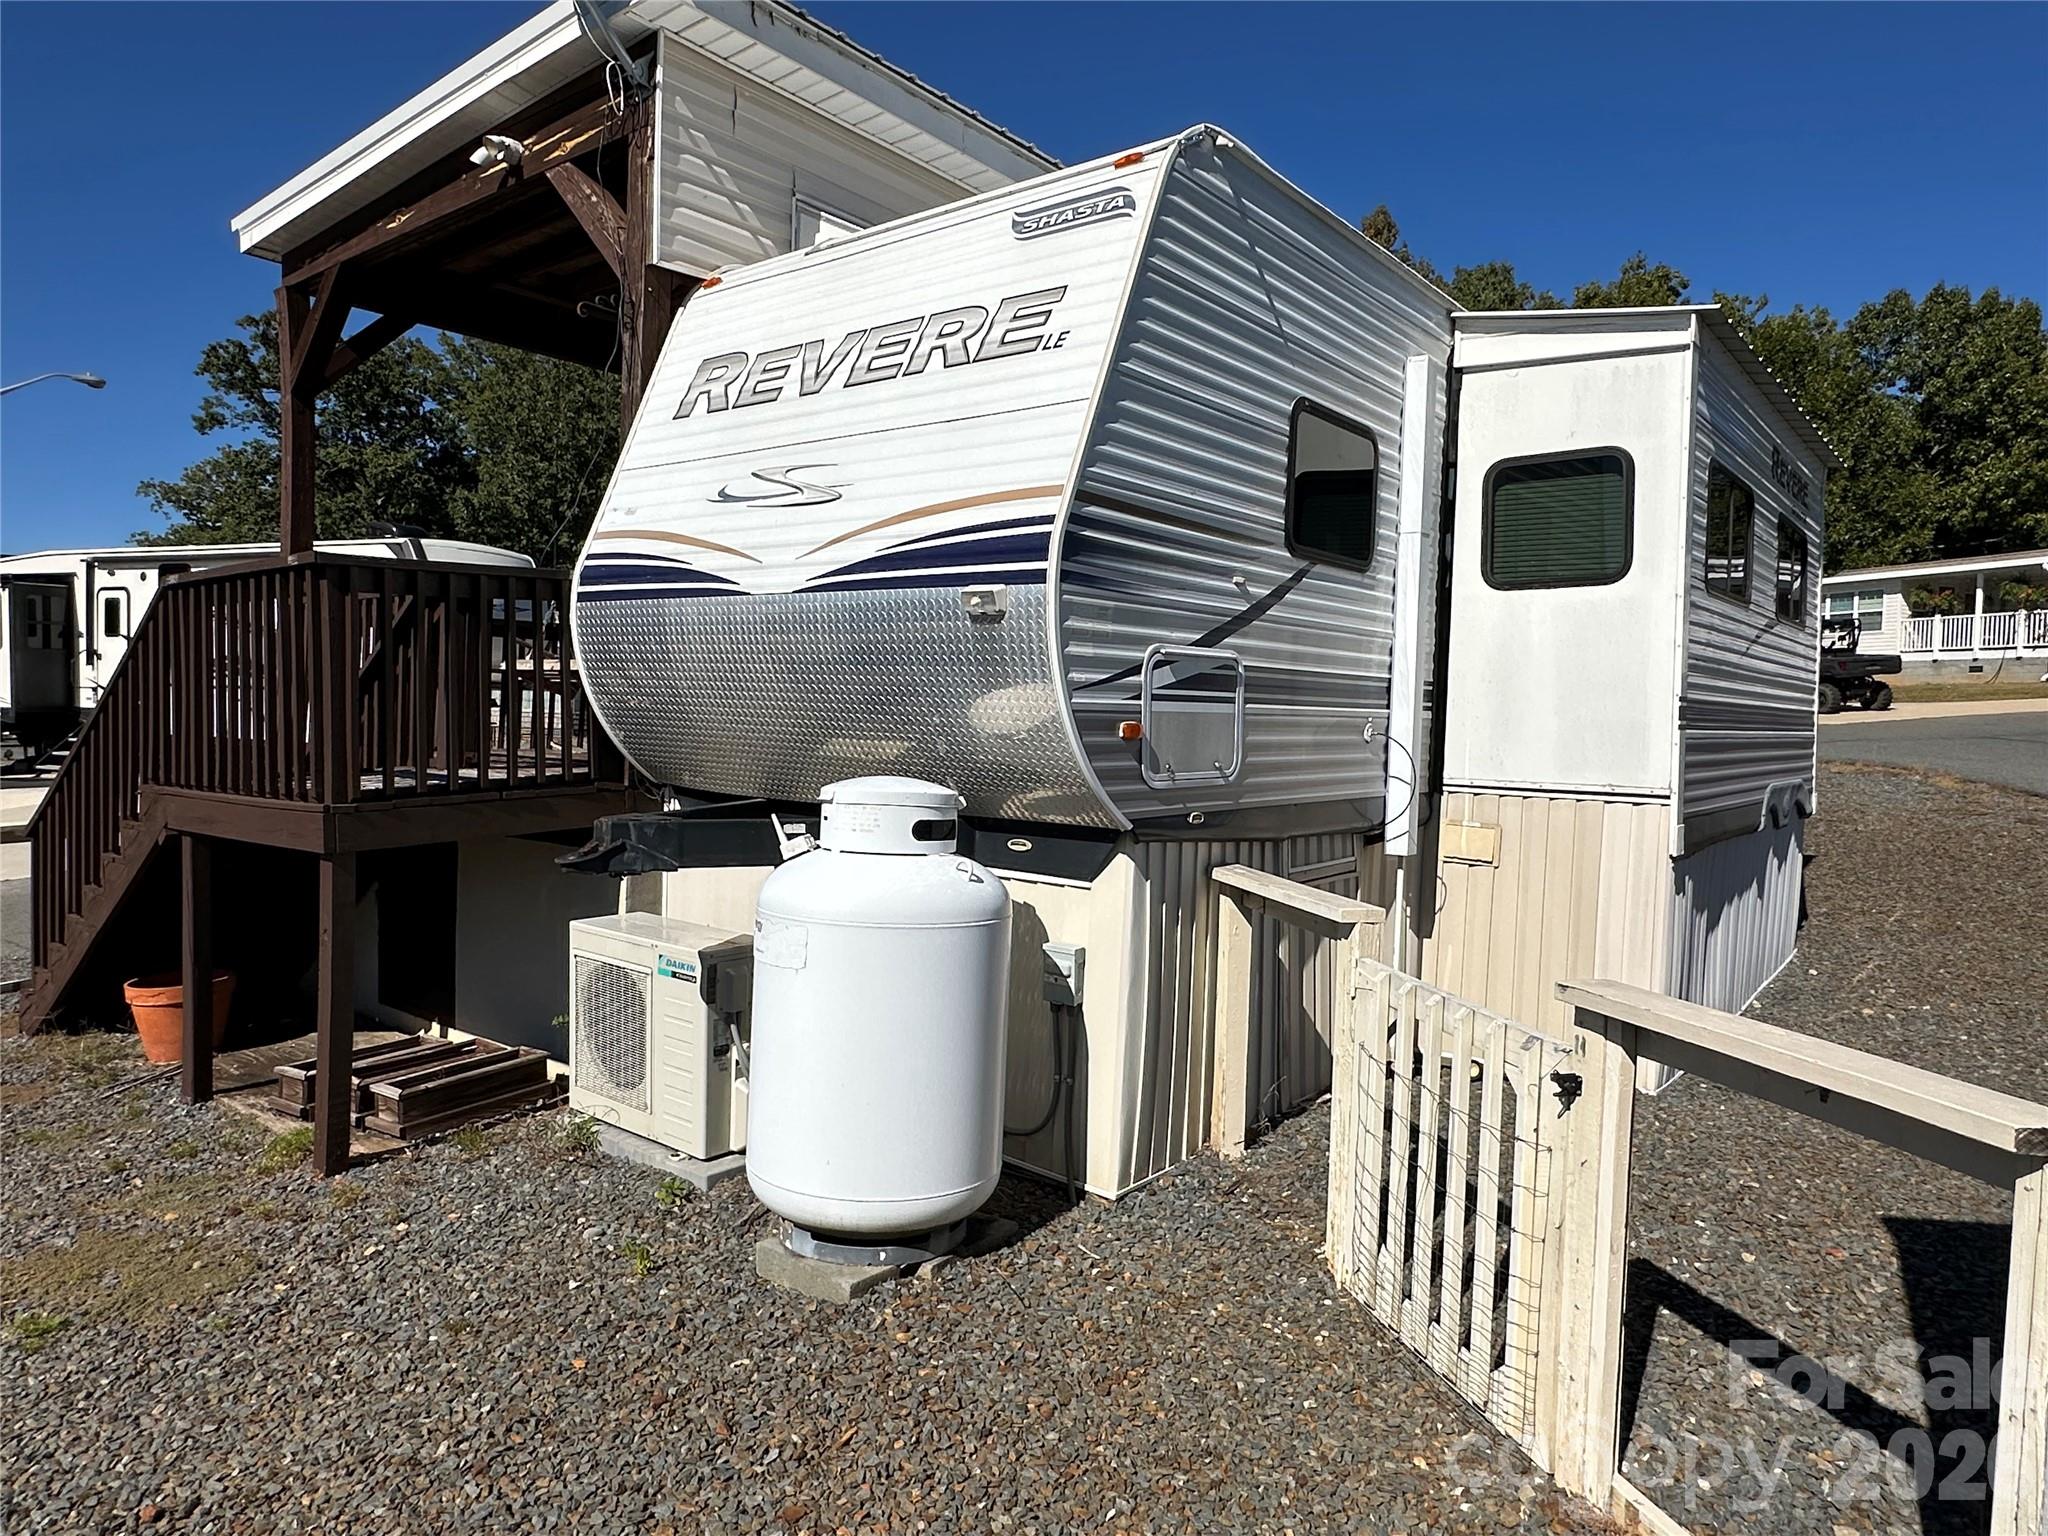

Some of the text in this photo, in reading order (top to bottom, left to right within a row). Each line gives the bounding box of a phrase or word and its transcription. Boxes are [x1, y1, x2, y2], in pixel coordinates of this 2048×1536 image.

[1021, 195, 1125, 233] SHASTA
[672, 285, 1070, 420] REVERE LE
[665, 958, 697, 974] DAIKIN
